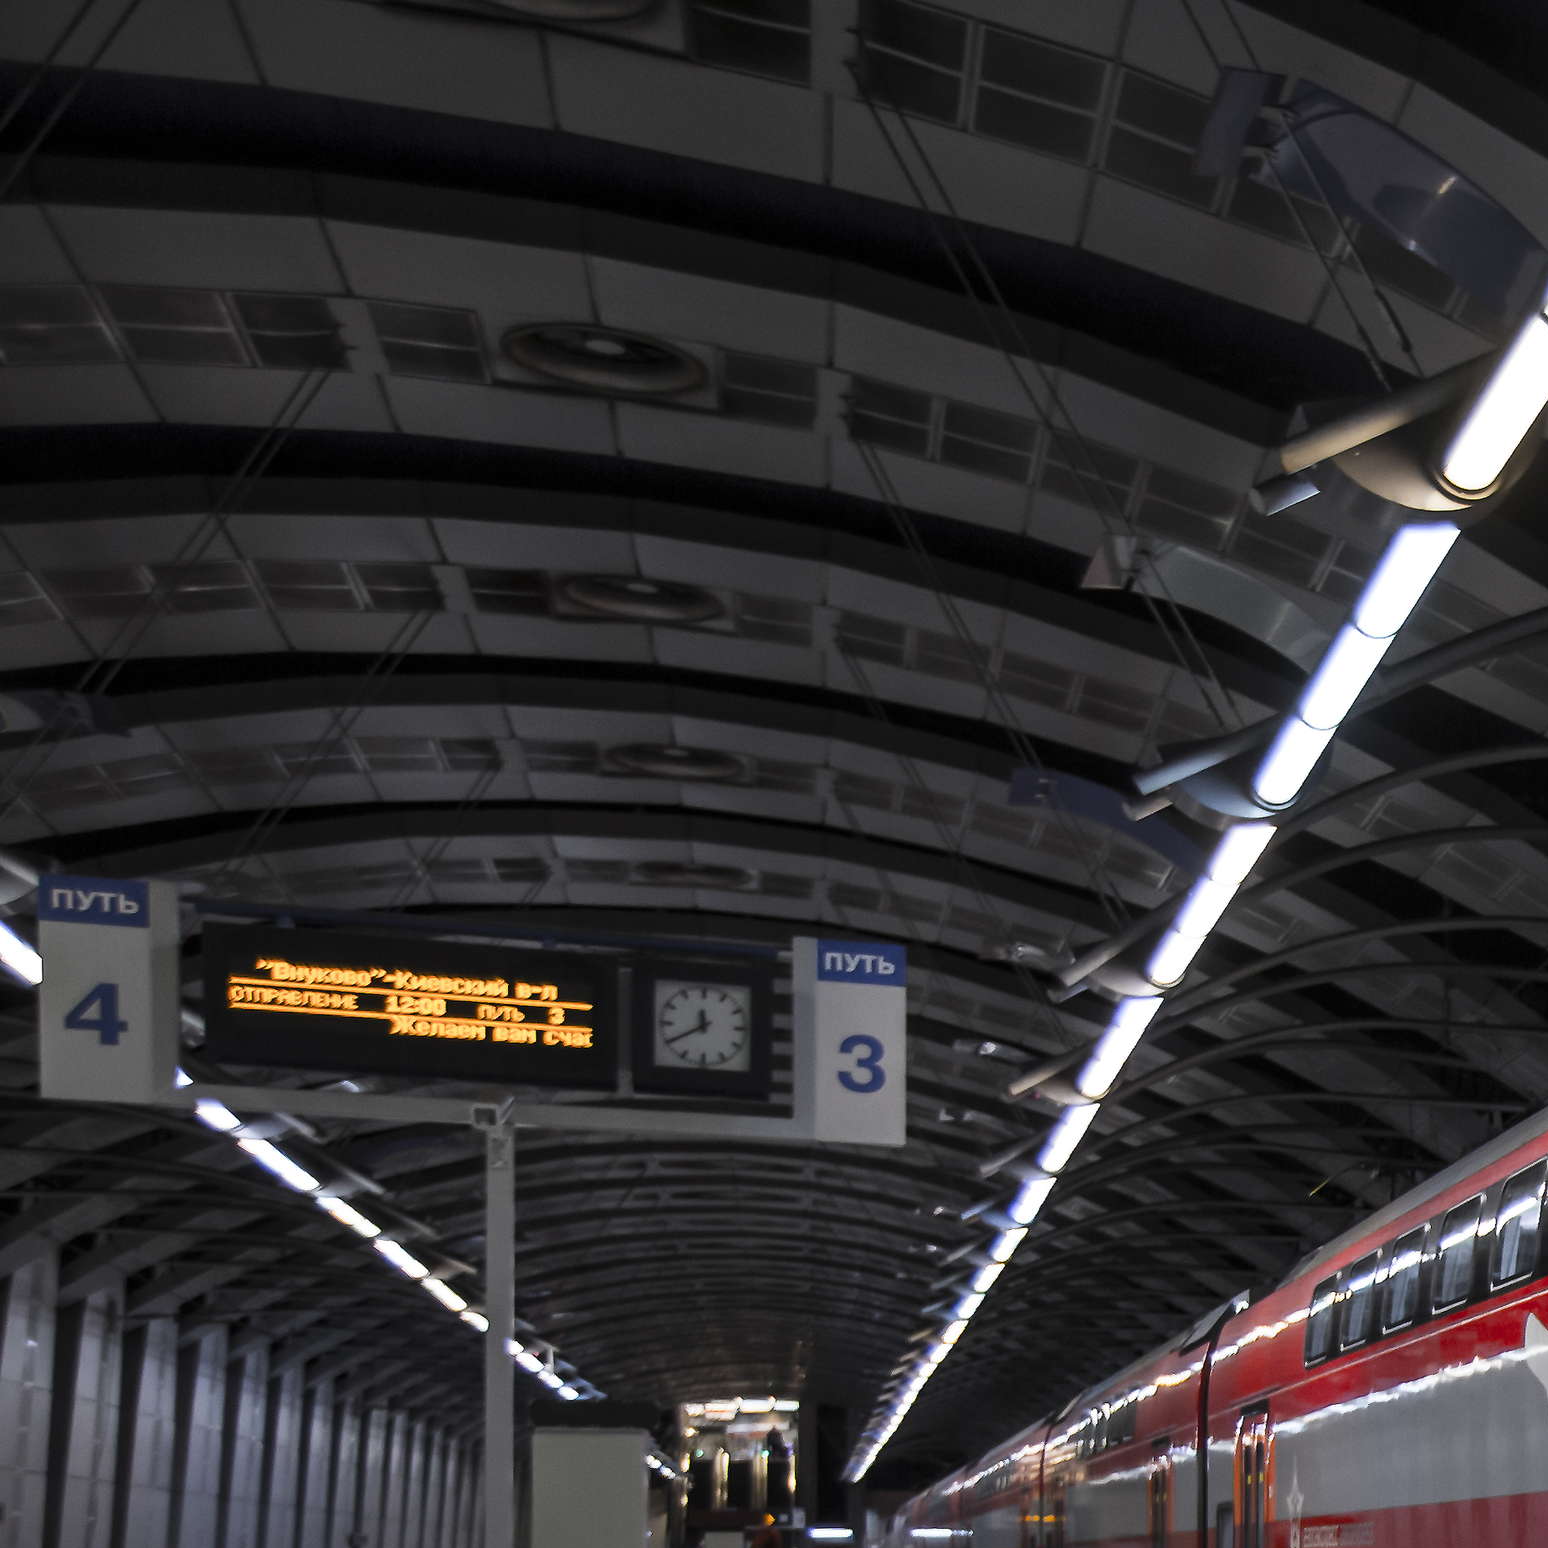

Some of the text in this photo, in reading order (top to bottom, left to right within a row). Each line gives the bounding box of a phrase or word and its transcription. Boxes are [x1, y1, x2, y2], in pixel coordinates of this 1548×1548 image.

[52, 888, 139, 914] ПУТЬ
[824, 951, 896, 975] ПУТЬ
[63, 980, 129, 1046] 4
[385, 995, 447, 1017] 12:00
[547, 1006, 566, 1025] 3
[389, 1015, 487, 1041] Желаем
[837, 1033, 887, 1094] 3
